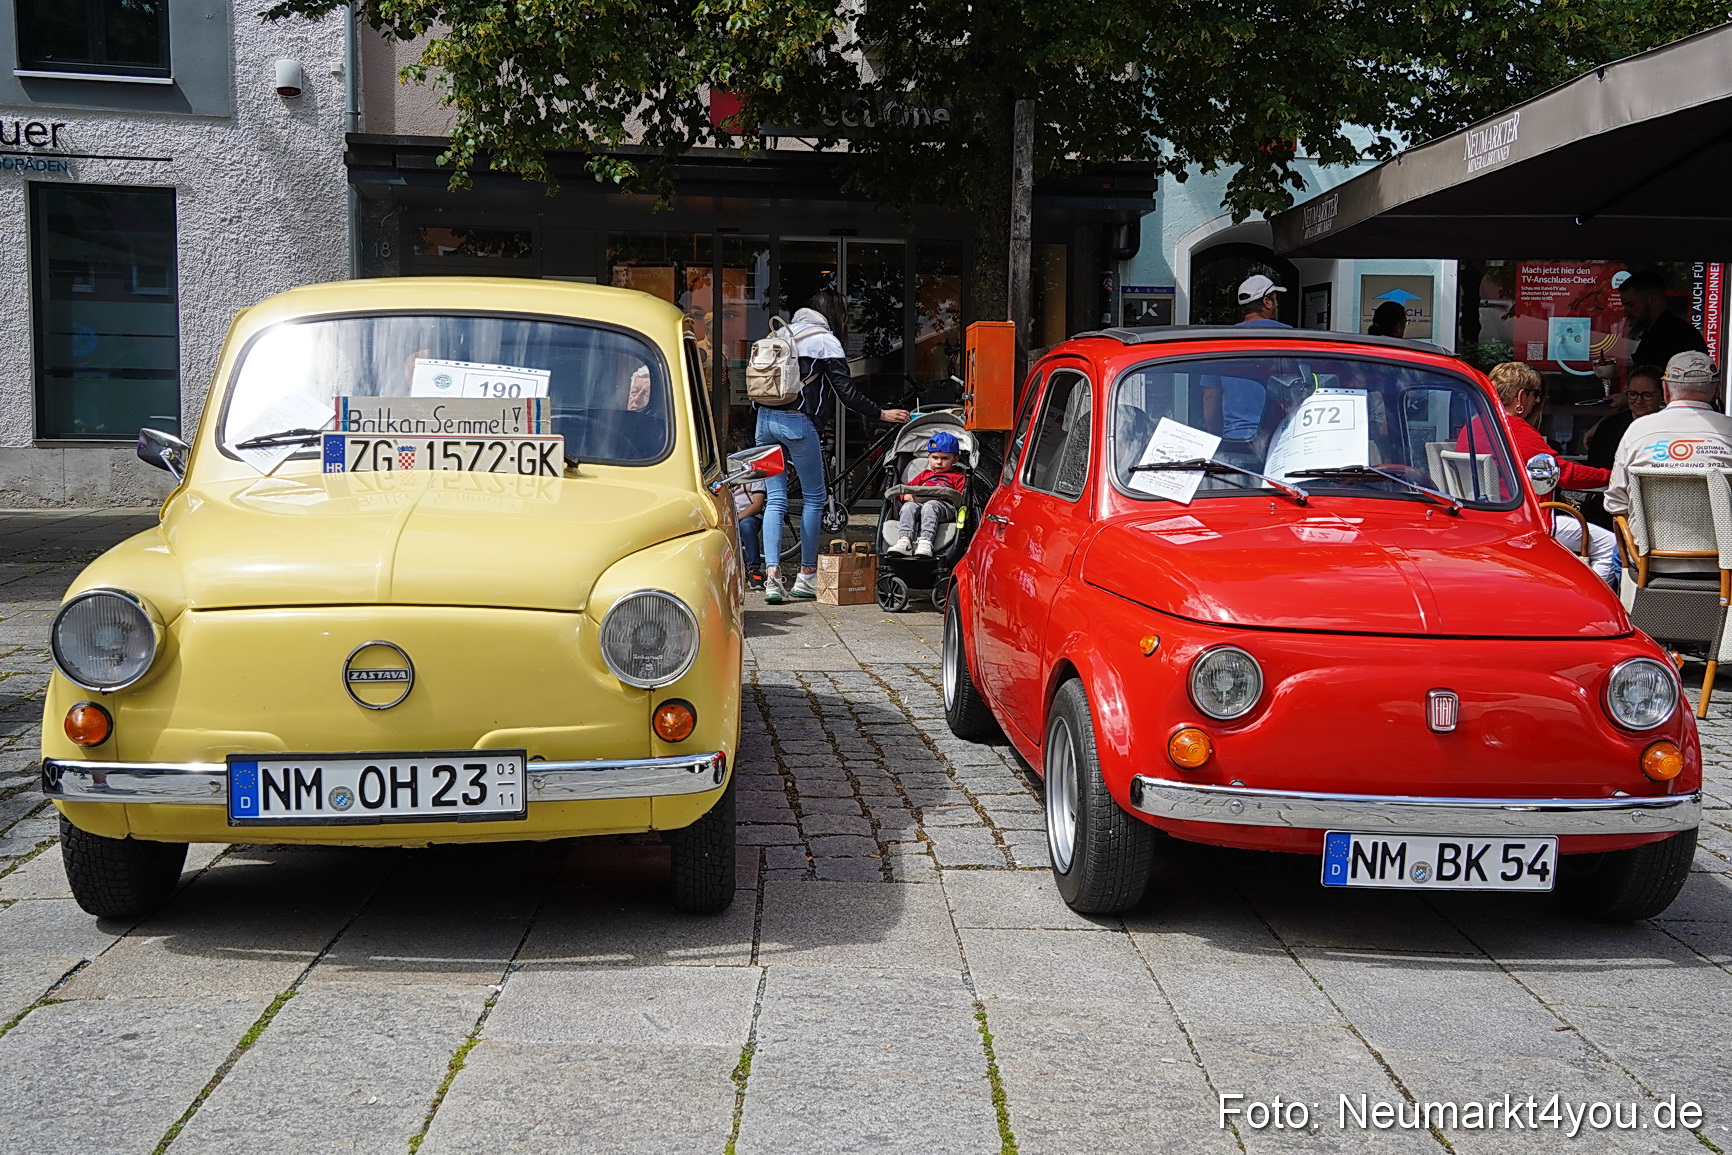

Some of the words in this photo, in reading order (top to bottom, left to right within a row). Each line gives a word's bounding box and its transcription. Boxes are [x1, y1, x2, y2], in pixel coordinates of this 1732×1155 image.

[1463, 111, 1520, 160] NEUMARKTER
[0, 157, 68, 172] OPÄDEN
[372, 242, 391, 258] 18
[1521, 266, 1542, 274] Mach
[1542, 266, 1560, 276] jetzt
[1560, 266, 1575, 274] hier
[1576, 267, 1591, 275] den
[1692, 261, 1704, 279] FÜ
[1692, 282, 1703, 312] AUCH
[1707, 262, 1720, 361] HAFTSKUND:INNE
[479, 381, 522, 398] 190
[348, 407, 426, 433] Balkan
[1302, 406, 1341, 427] 572
[350, 440, 393, 472] ZG
[326, 463, 343, 473] HR
[350, 670, 408, 681] ZASTAVA
[1435, 697, 1454, 726] FIAT
[496, 763, 516, 776] 03
[261, 767, 323, 811] NM
[358, 765, 419, 809] OH
[431, 763, 488, 807] 23
[240, 796, 251, 809] D
[498, 793, 515, 806] 11
[1350, 840, 1408, 880] NM
[1436, 842, 1492, 882] BK
[1500, 843, 1550, 882] 54
[1331, 864, 1341, 876] D
